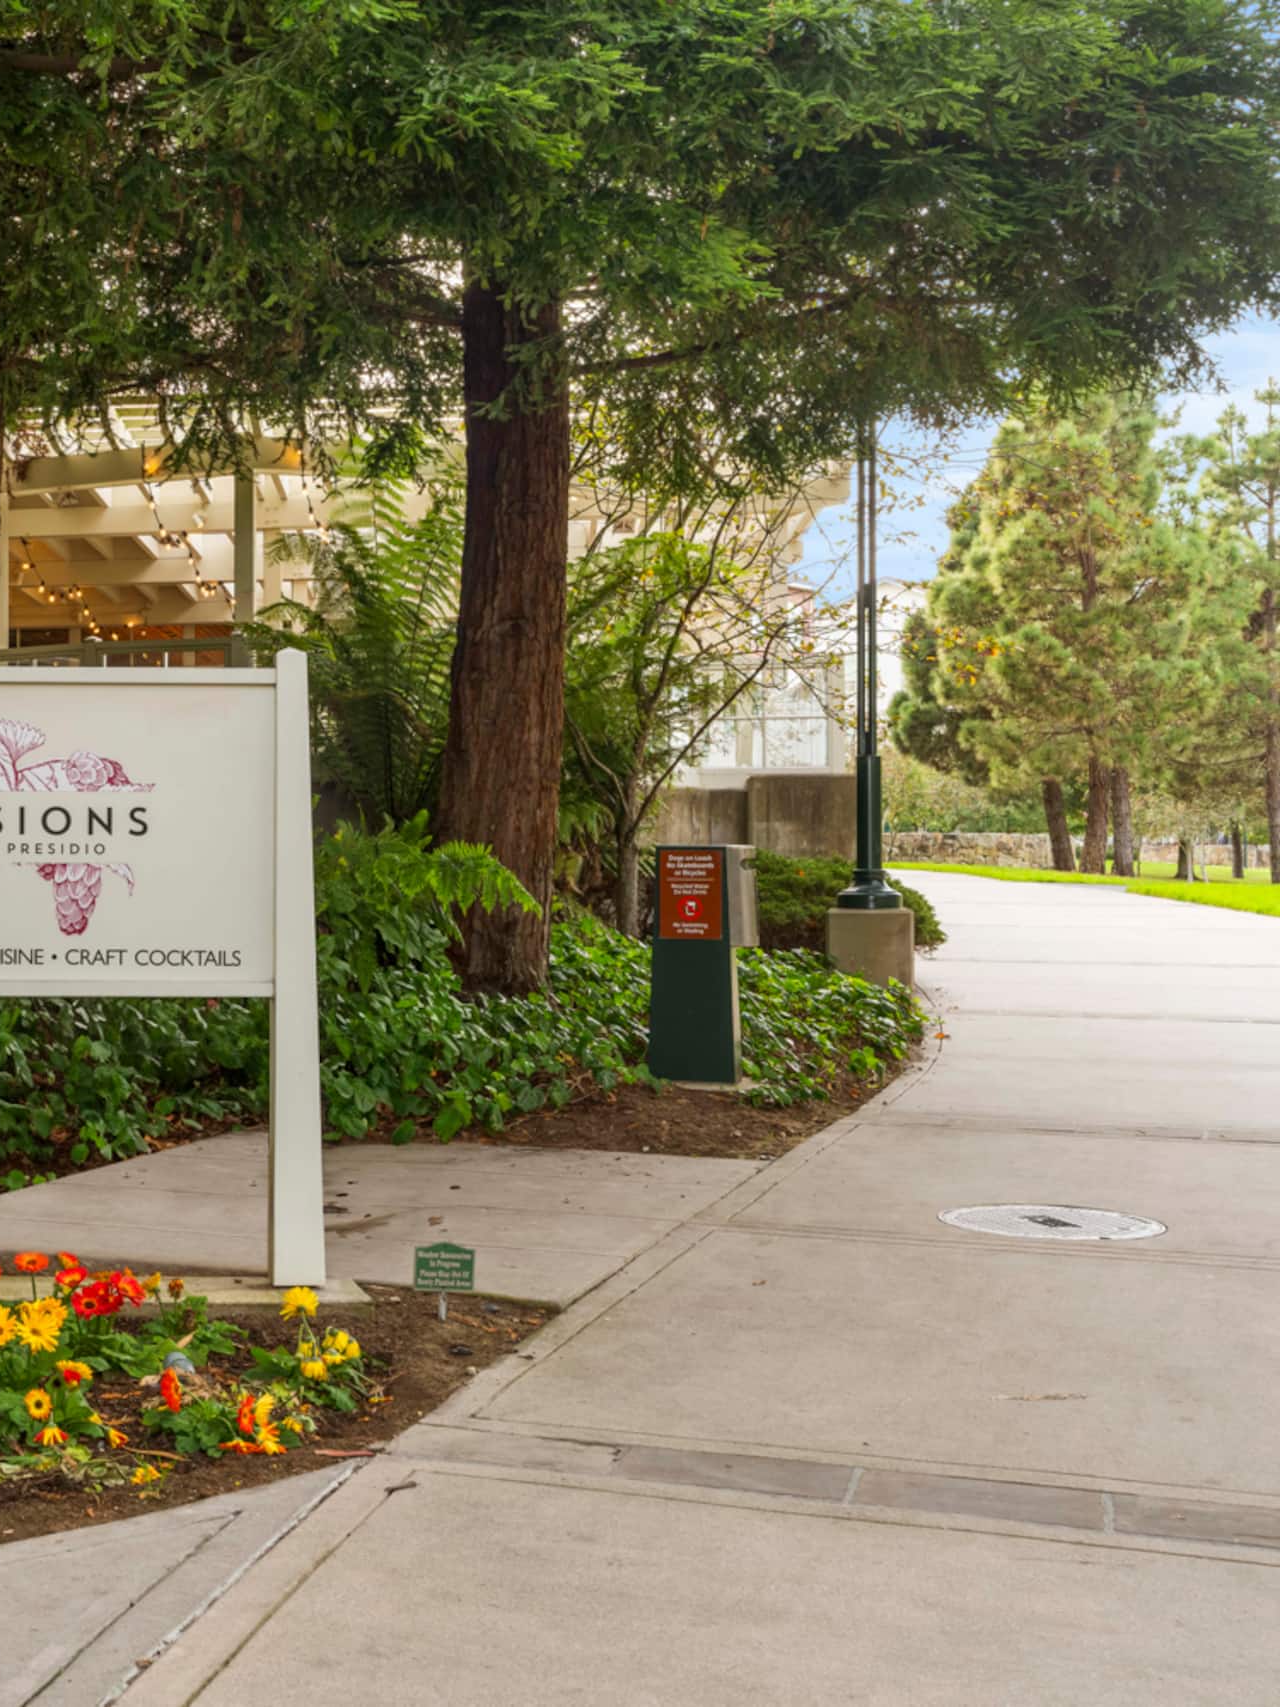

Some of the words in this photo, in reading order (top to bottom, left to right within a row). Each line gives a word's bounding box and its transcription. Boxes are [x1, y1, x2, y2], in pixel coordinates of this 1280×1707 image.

[7, 842, 106, 855] PRESIDIO
[64, 948, 129, 966] CRAFT
[134, 948, 242, 968] COCKTAILS
